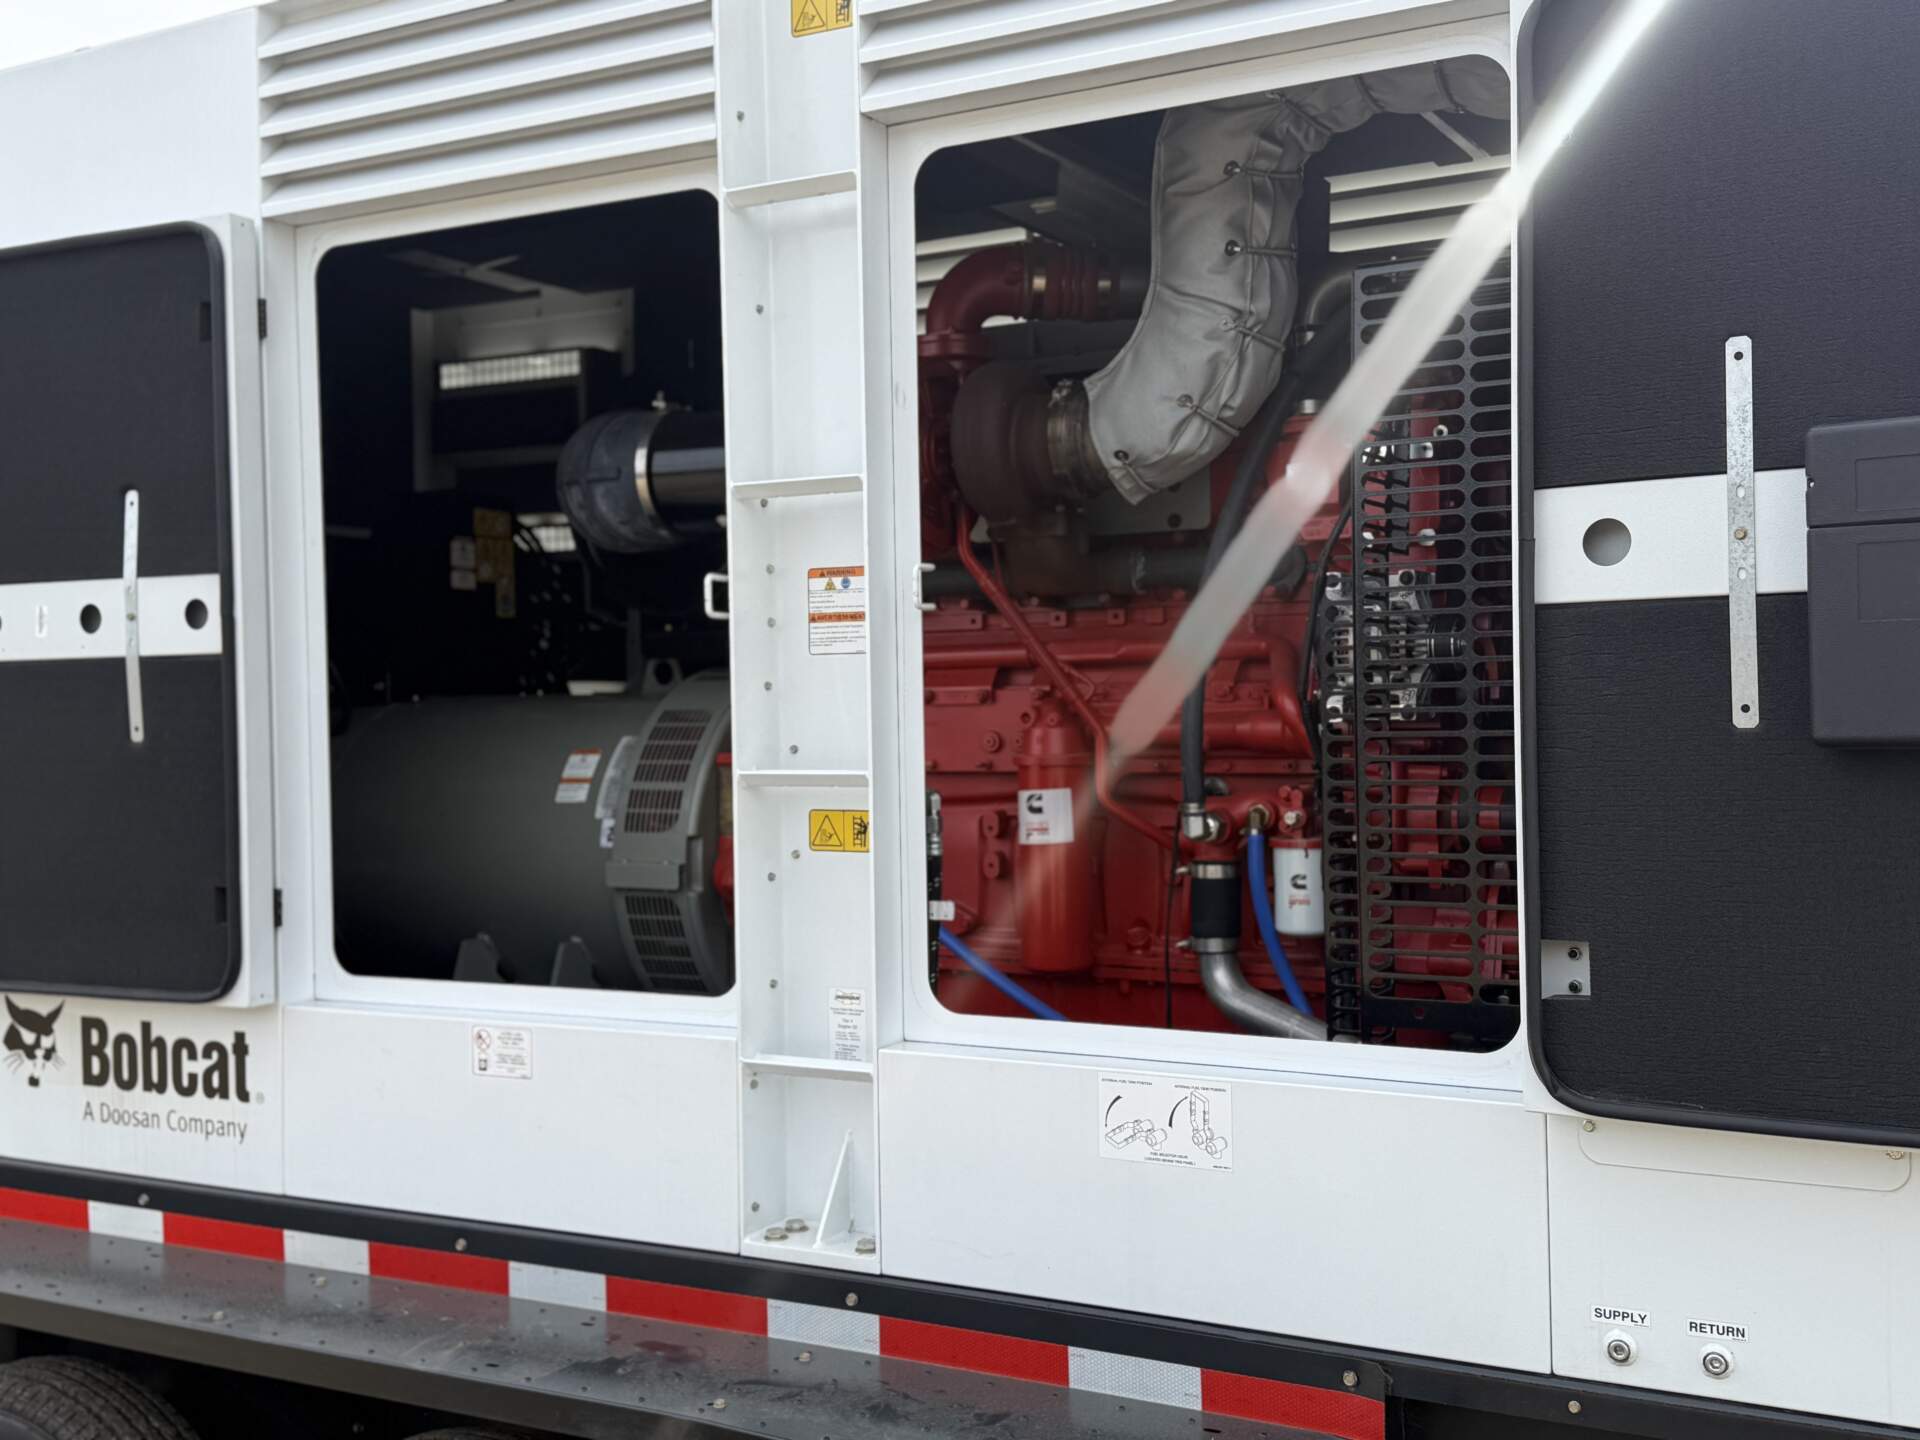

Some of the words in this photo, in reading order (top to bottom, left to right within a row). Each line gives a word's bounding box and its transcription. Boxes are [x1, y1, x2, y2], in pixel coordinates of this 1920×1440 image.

[81, 1016, 250, 1103] Bobcat
[83, 1101, 95, 1121] A
[100, 1102, 160, 1129] Doosan
[166, 1110, 247, 1144] Company
[1594, 1307, 1647, 1324] SUPPLY
[1689, 1321, 1745, 1338] RETURN
